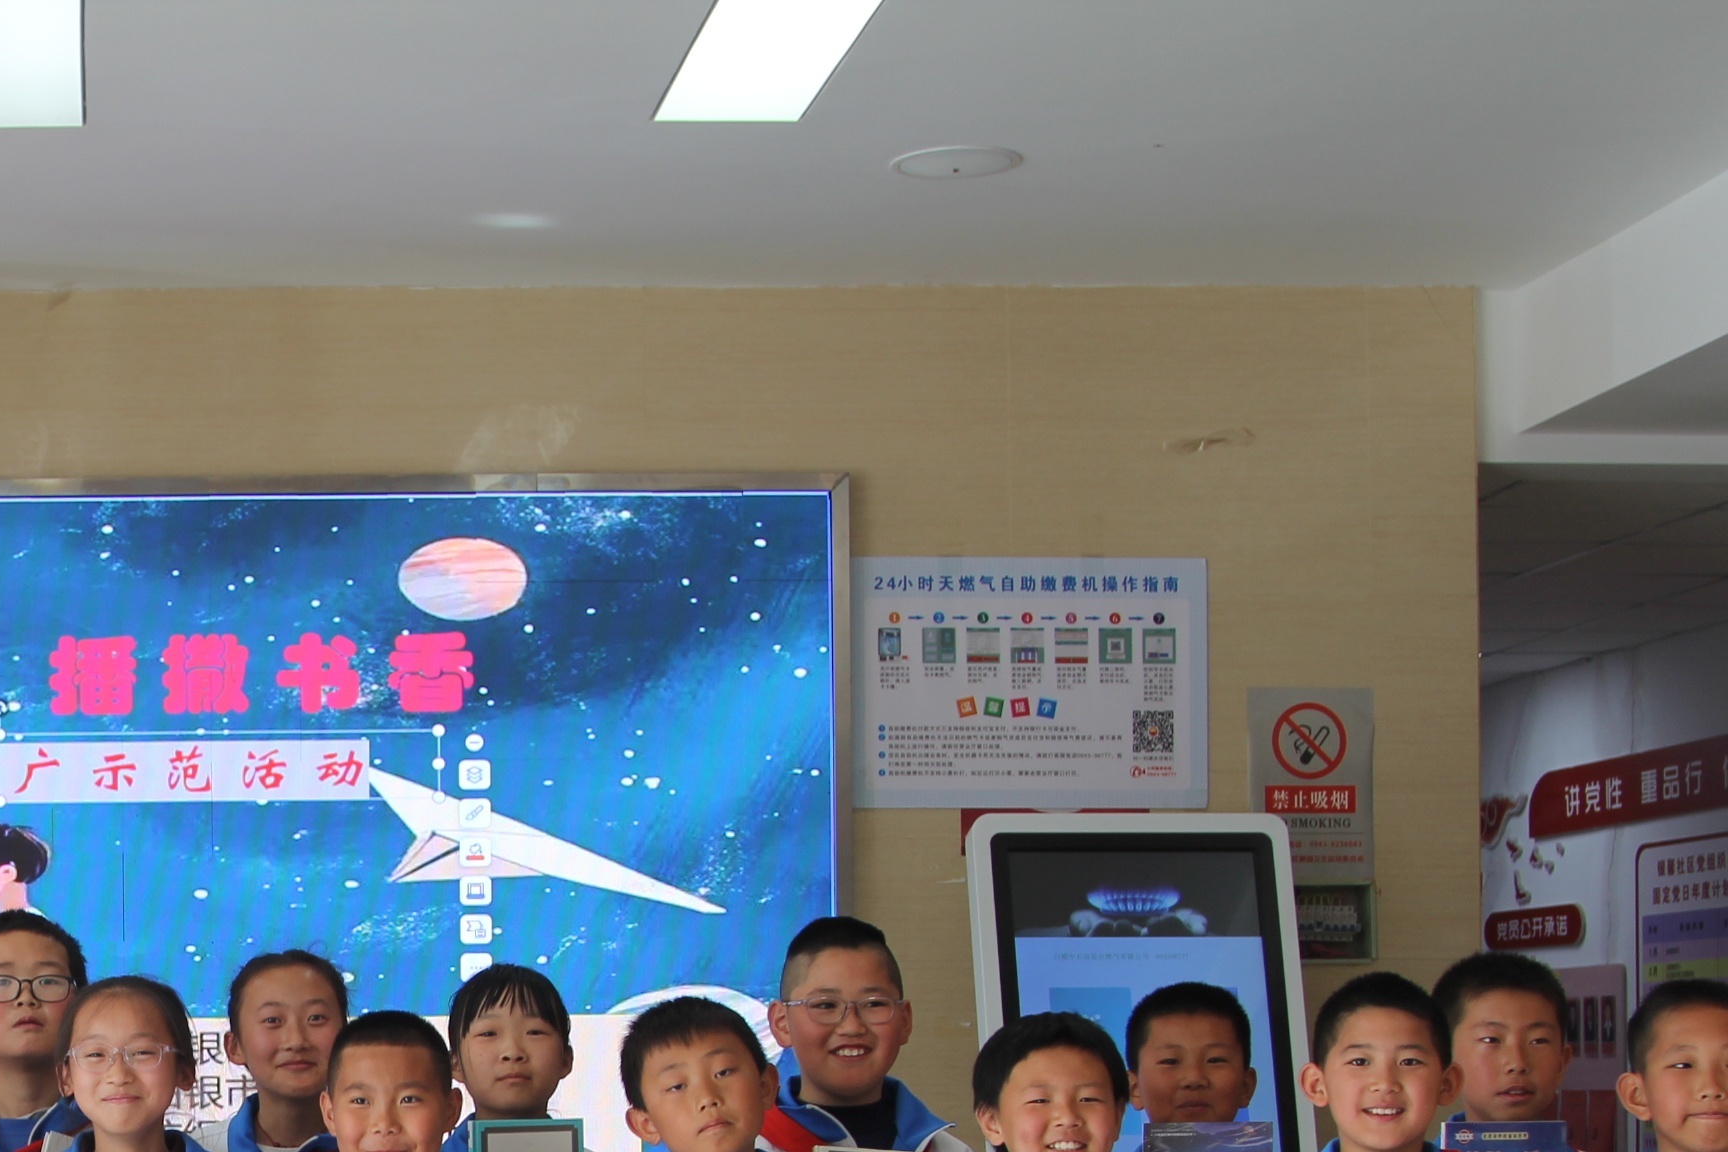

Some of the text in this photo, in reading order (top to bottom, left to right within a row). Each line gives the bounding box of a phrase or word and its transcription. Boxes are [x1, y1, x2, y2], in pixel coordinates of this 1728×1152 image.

[874, 575, 1179, 592] 24小时天燃气自助缴费机操作指南
[50, 631, 474, 716] 播撒书香
[1273, 789, 1349, 810] 禁止吸烟
[1565, 760, 1702, 818] 讲党性 重品行
[1290, 818, 1351, 828] SMOKING
[1497, 915, 1568, 941] 党员公开承诺
